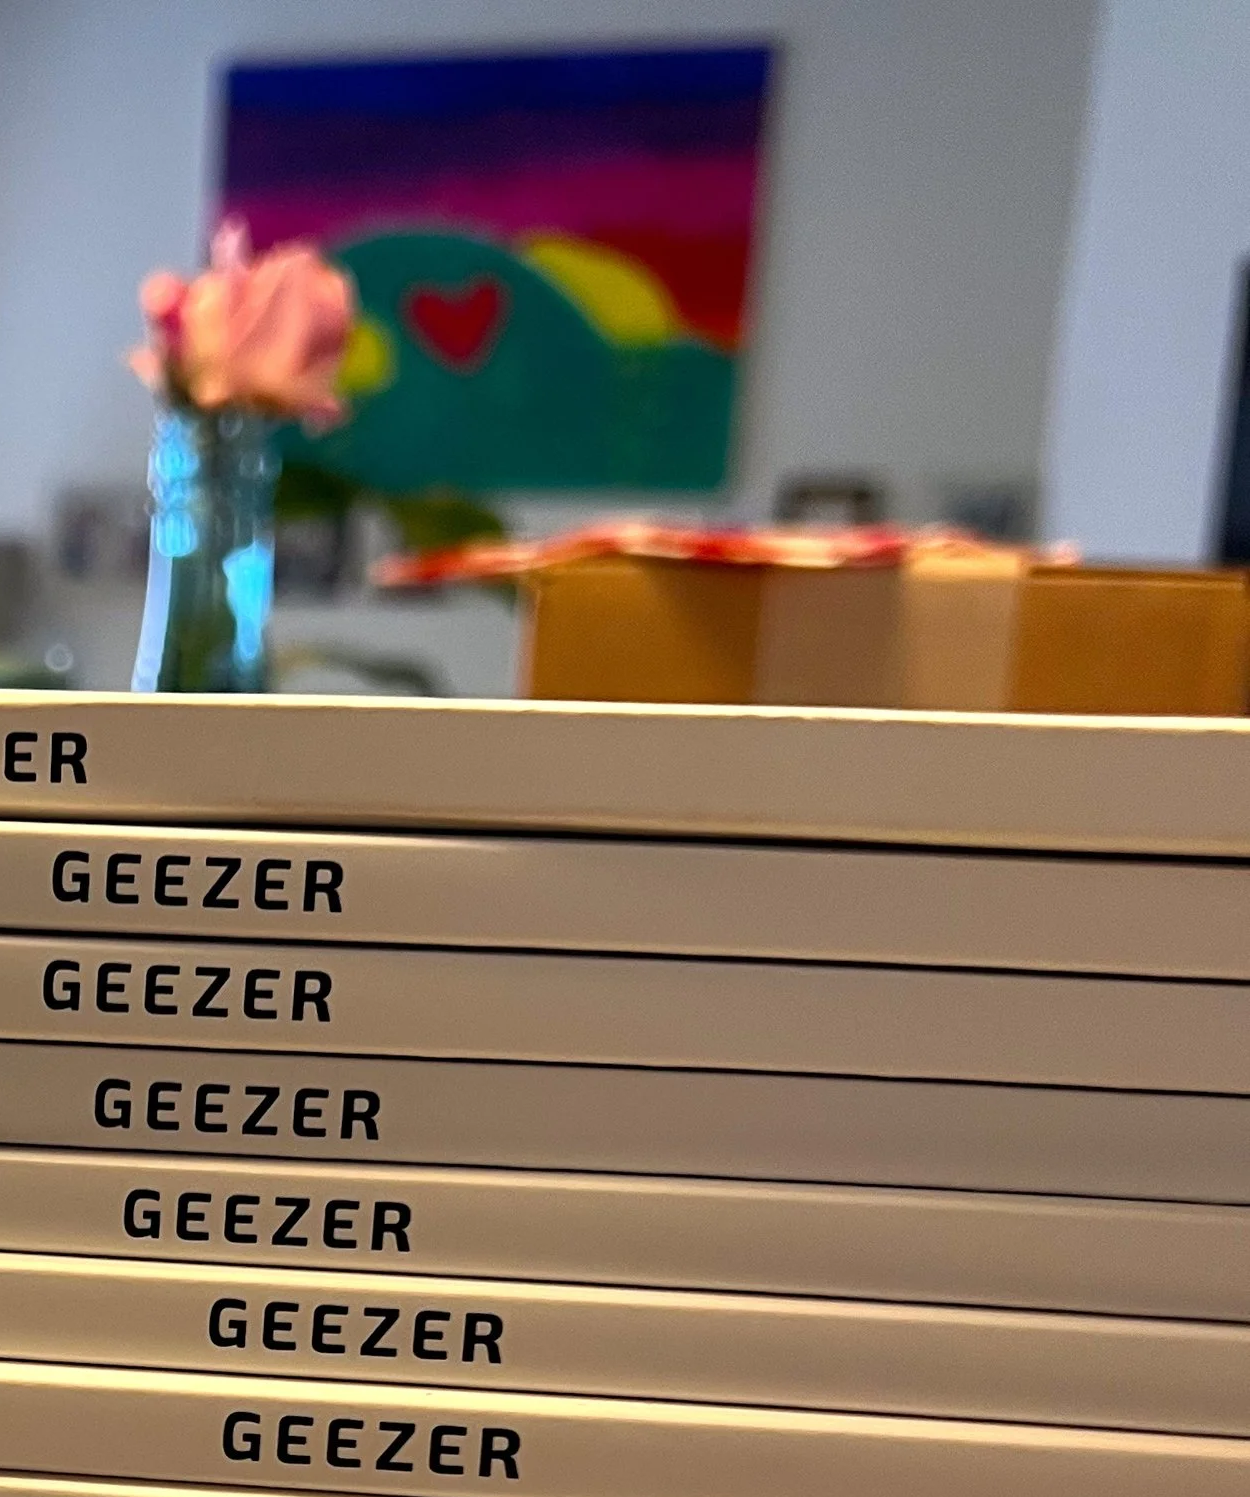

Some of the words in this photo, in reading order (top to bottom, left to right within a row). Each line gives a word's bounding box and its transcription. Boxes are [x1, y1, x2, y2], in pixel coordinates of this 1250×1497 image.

[52, 850, 344, 914] GEEZER
[42, 959, 333, 1023] GEEZER
[94, 1078, 381, 1141] GEEZER
[123, 1188, 412, 1253] GEEZER
[208, 1297, 504, 1365] GEEZER
[222, 1411, 521, 1480] GEEZER
